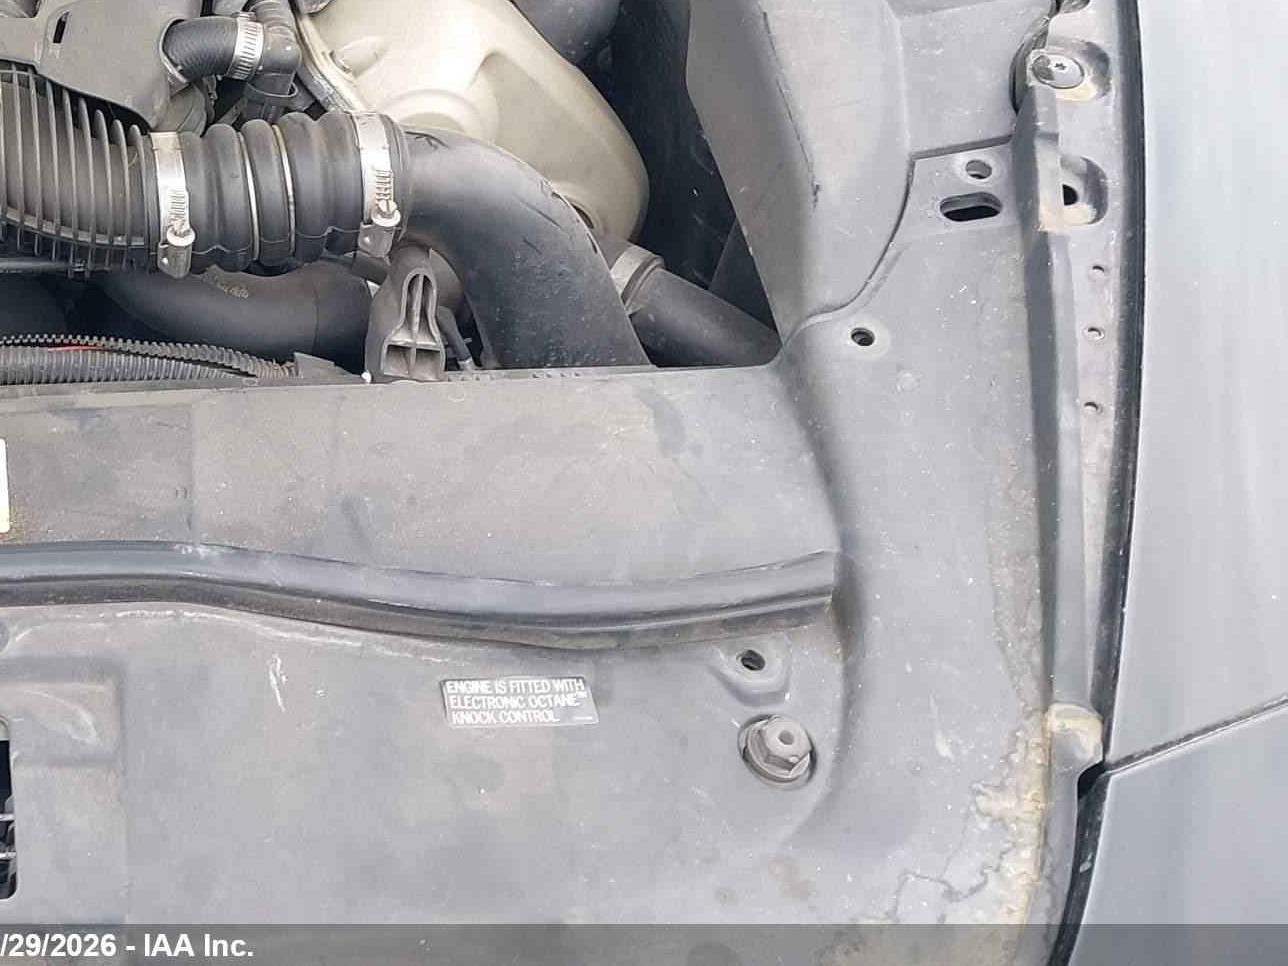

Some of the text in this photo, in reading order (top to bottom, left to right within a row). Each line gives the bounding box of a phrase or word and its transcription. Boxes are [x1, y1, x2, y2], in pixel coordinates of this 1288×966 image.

[446, 678, 585, 694] ENGINE IS FITTED WITH
[450, 695, 525, 709] ELECTRONIC
[452, 710, 498, 724] KNOCK
[499, 709, 560, 723] CONTROL
